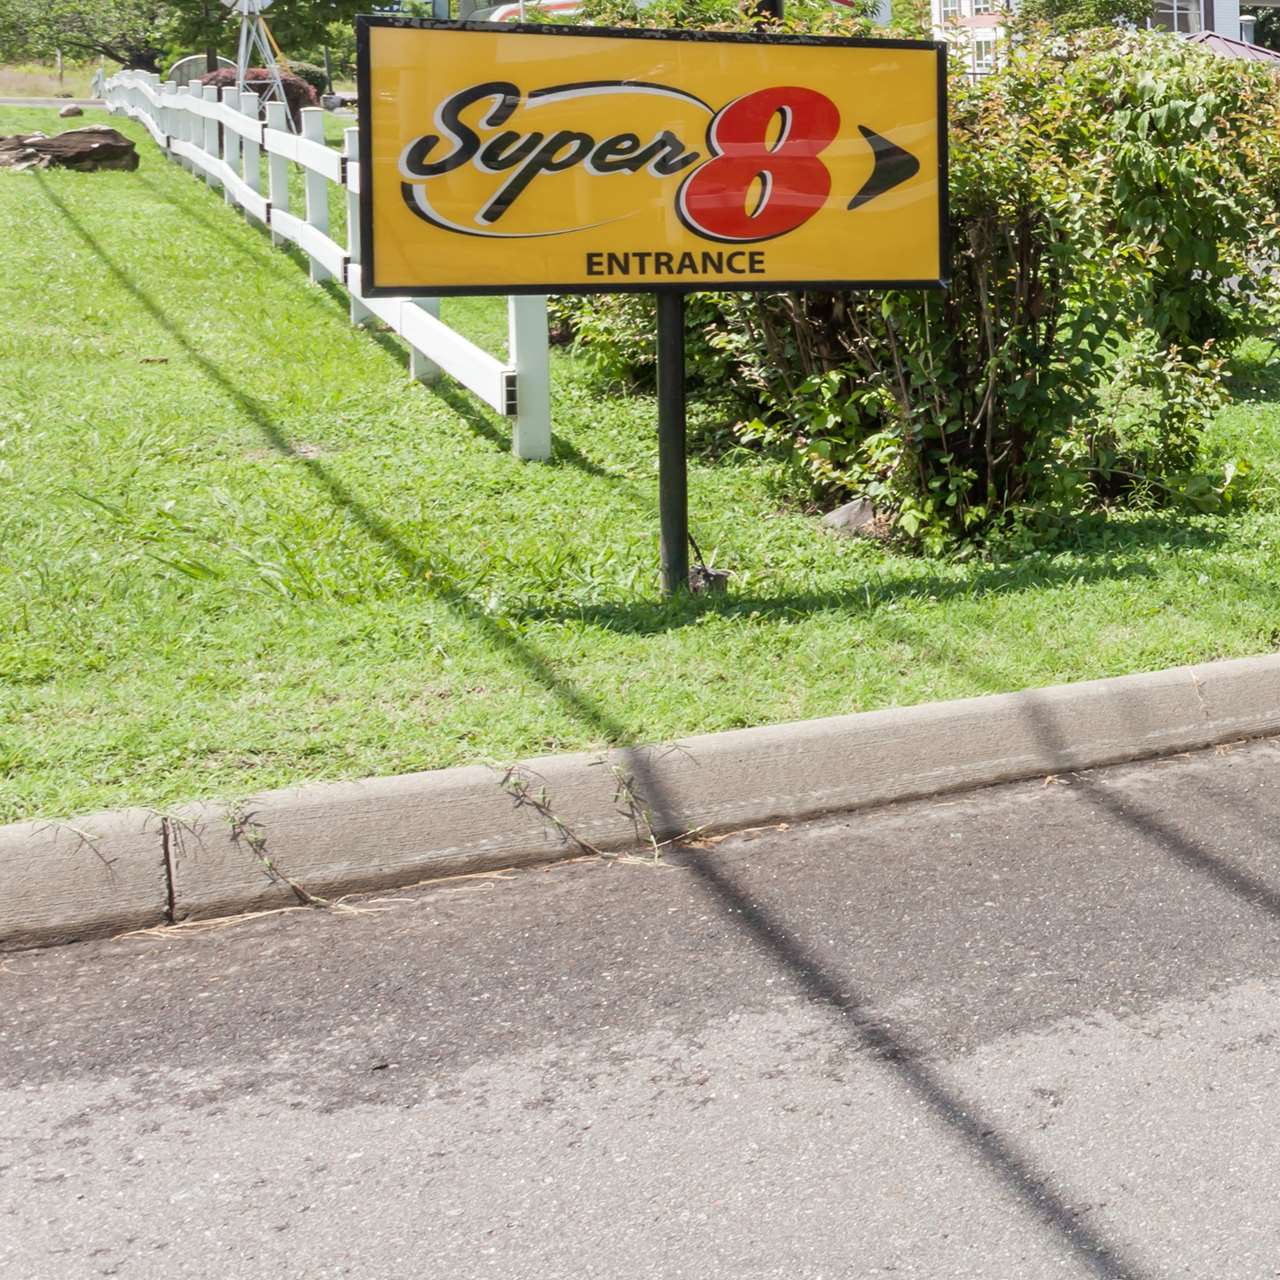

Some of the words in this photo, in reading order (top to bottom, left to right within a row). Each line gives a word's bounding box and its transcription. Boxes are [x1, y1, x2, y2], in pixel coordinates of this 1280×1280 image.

[399, 81, 700, 226] Super
[675, 86, 841, 244] 8
[586, 251, 766, 277] ENTRANCE
